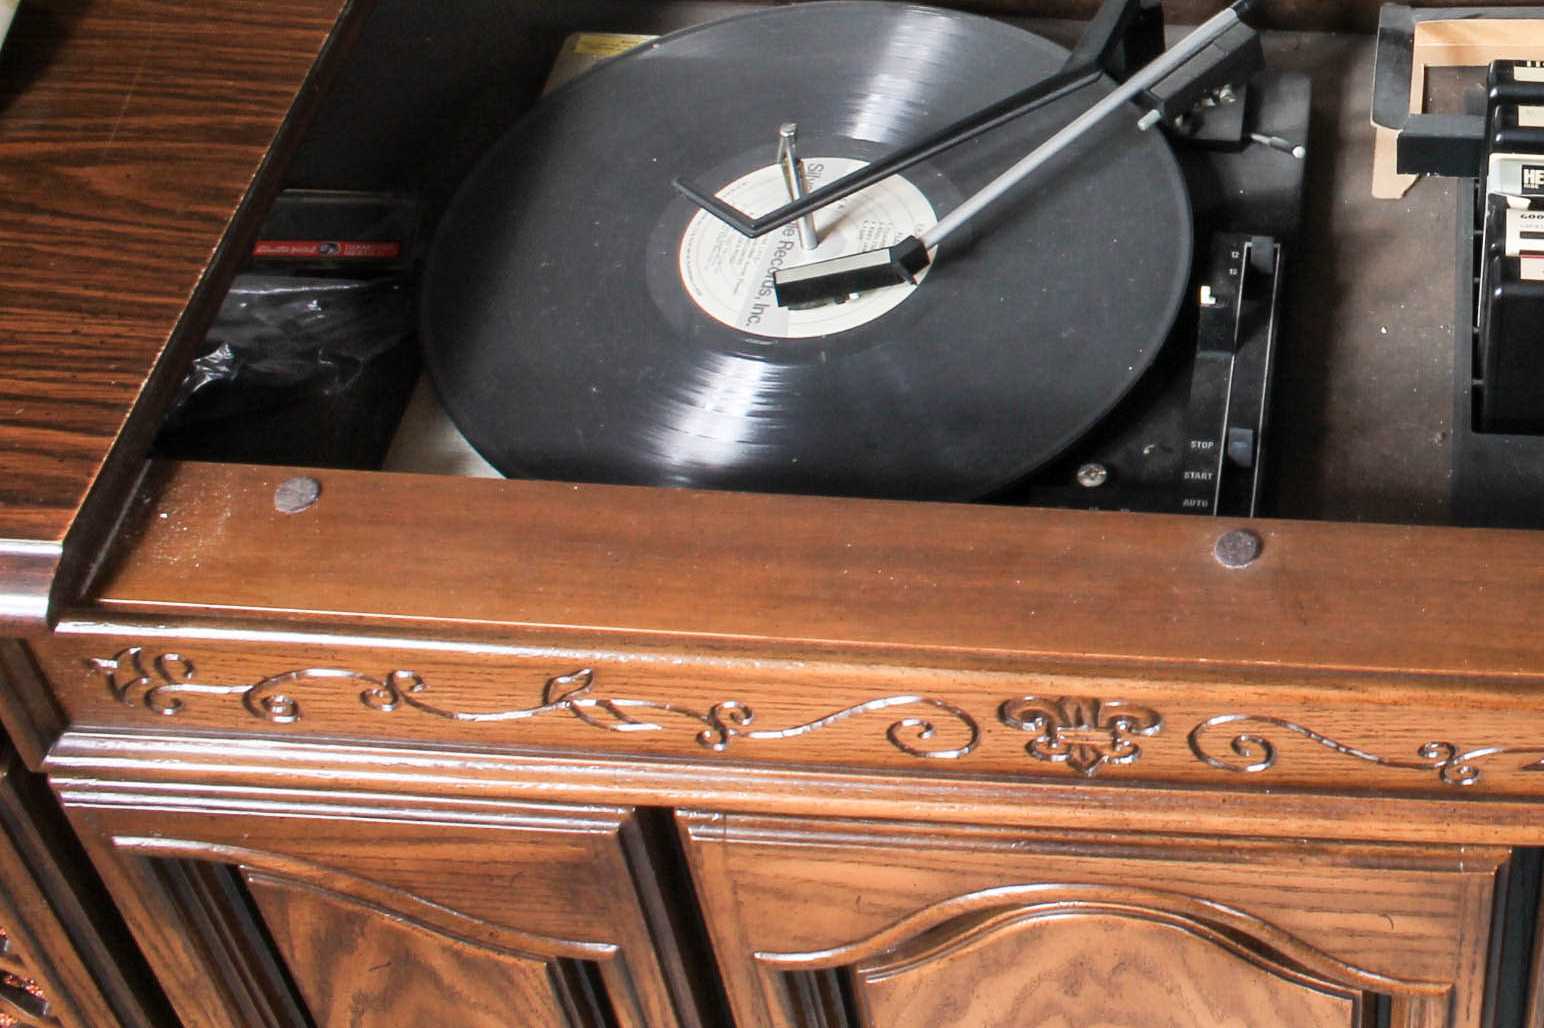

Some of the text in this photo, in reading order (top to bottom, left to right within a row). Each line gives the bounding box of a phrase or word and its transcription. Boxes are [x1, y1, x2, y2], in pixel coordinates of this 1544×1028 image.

[745, 302, 772, 327] Inc.
[1190, 440, 1215, 449] STOP
[1183, 471, 1214, 481] START
[1182, 499, 1209, 508] AUTO
